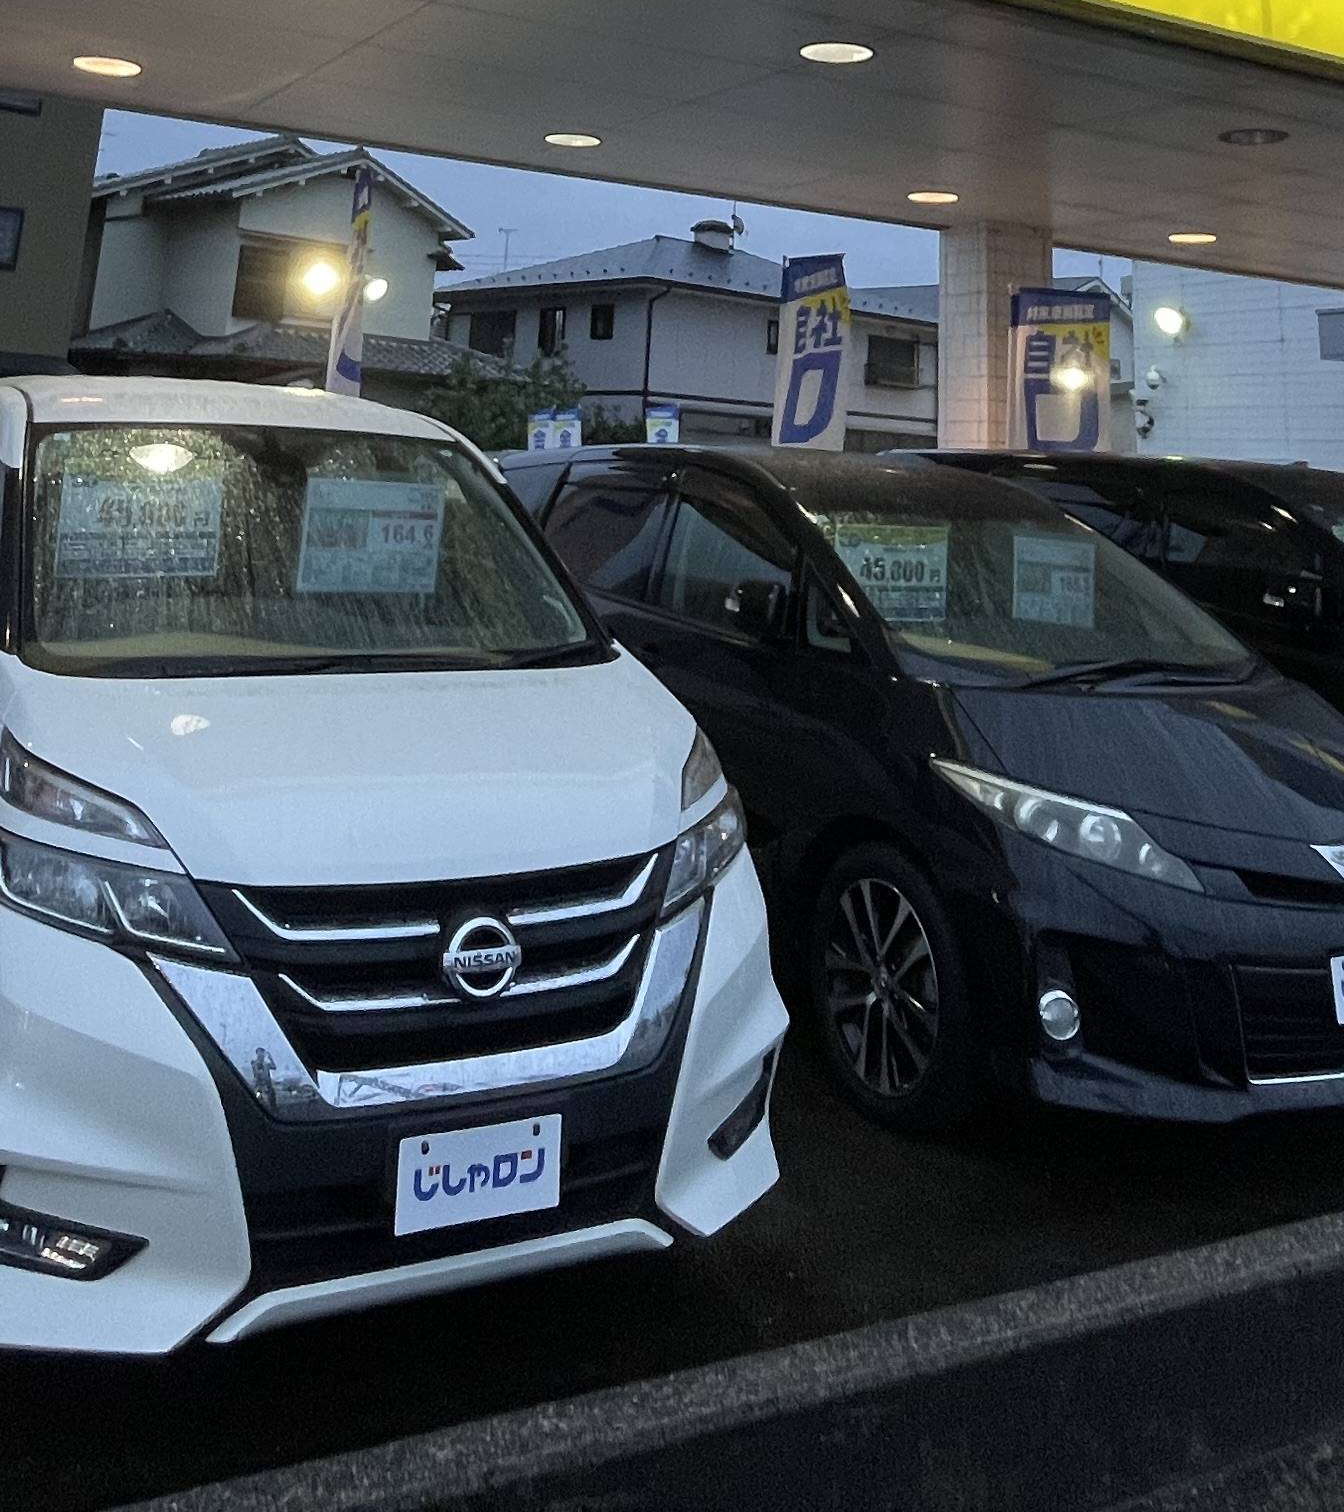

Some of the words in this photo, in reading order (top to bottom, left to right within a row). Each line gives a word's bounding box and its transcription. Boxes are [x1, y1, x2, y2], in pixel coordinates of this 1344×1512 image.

[381, 523, 434, 545] 164.6
[453, 950, 516, 968] NISSAN
[413, 1147, 546, 1202] じしゃロン
